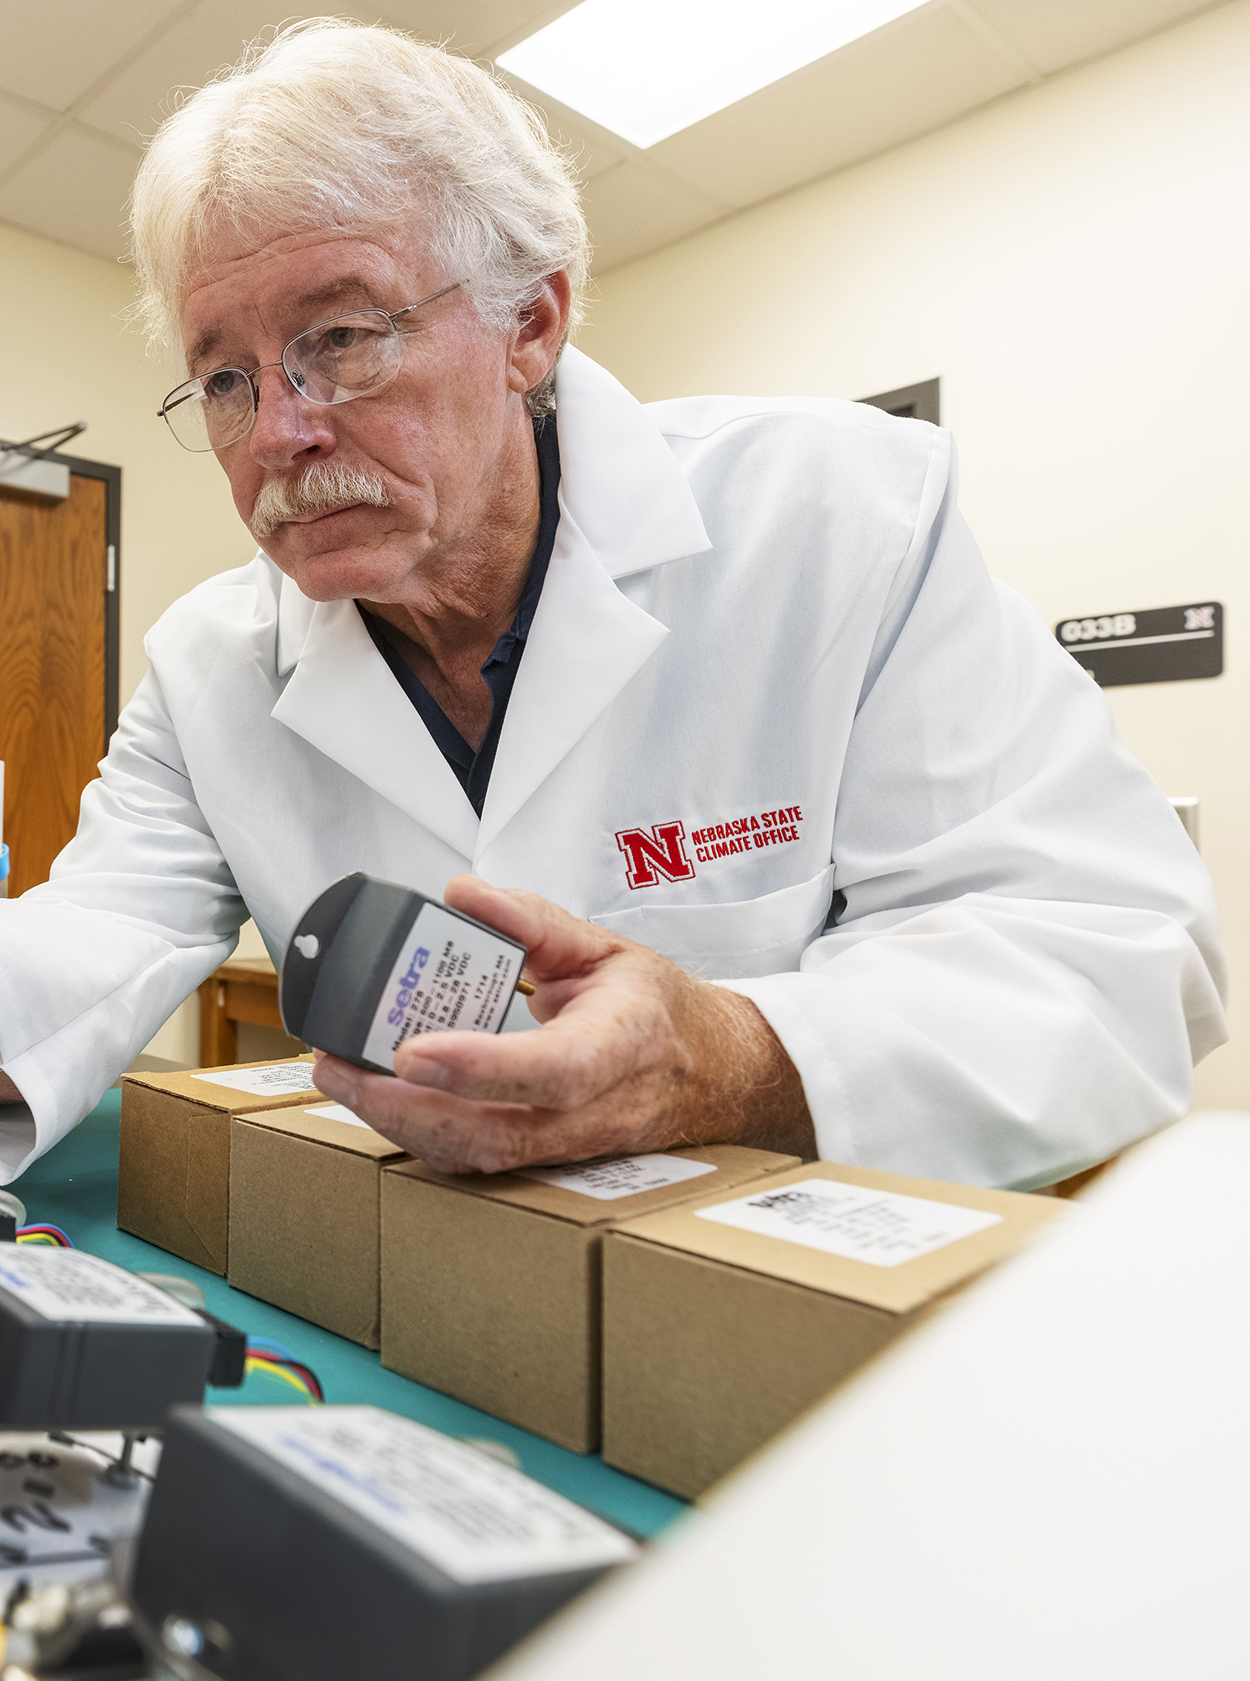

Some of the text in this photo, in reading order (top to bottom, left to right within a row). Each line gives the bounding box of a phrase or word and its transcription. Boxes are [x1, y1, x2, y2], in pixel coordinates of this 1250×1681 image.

[691, 805, 803, 846] NEBRASKA STATE
[696, 825, 800, 863] CLIMATE OFFICE
[615, 820, 696, 890] N
[444, 953, 460, 979] VDC
[455, 951, 471, 977] VDC
[387, 946, 430, 1027] setra
[473, 973, 489, 1000] 1714
